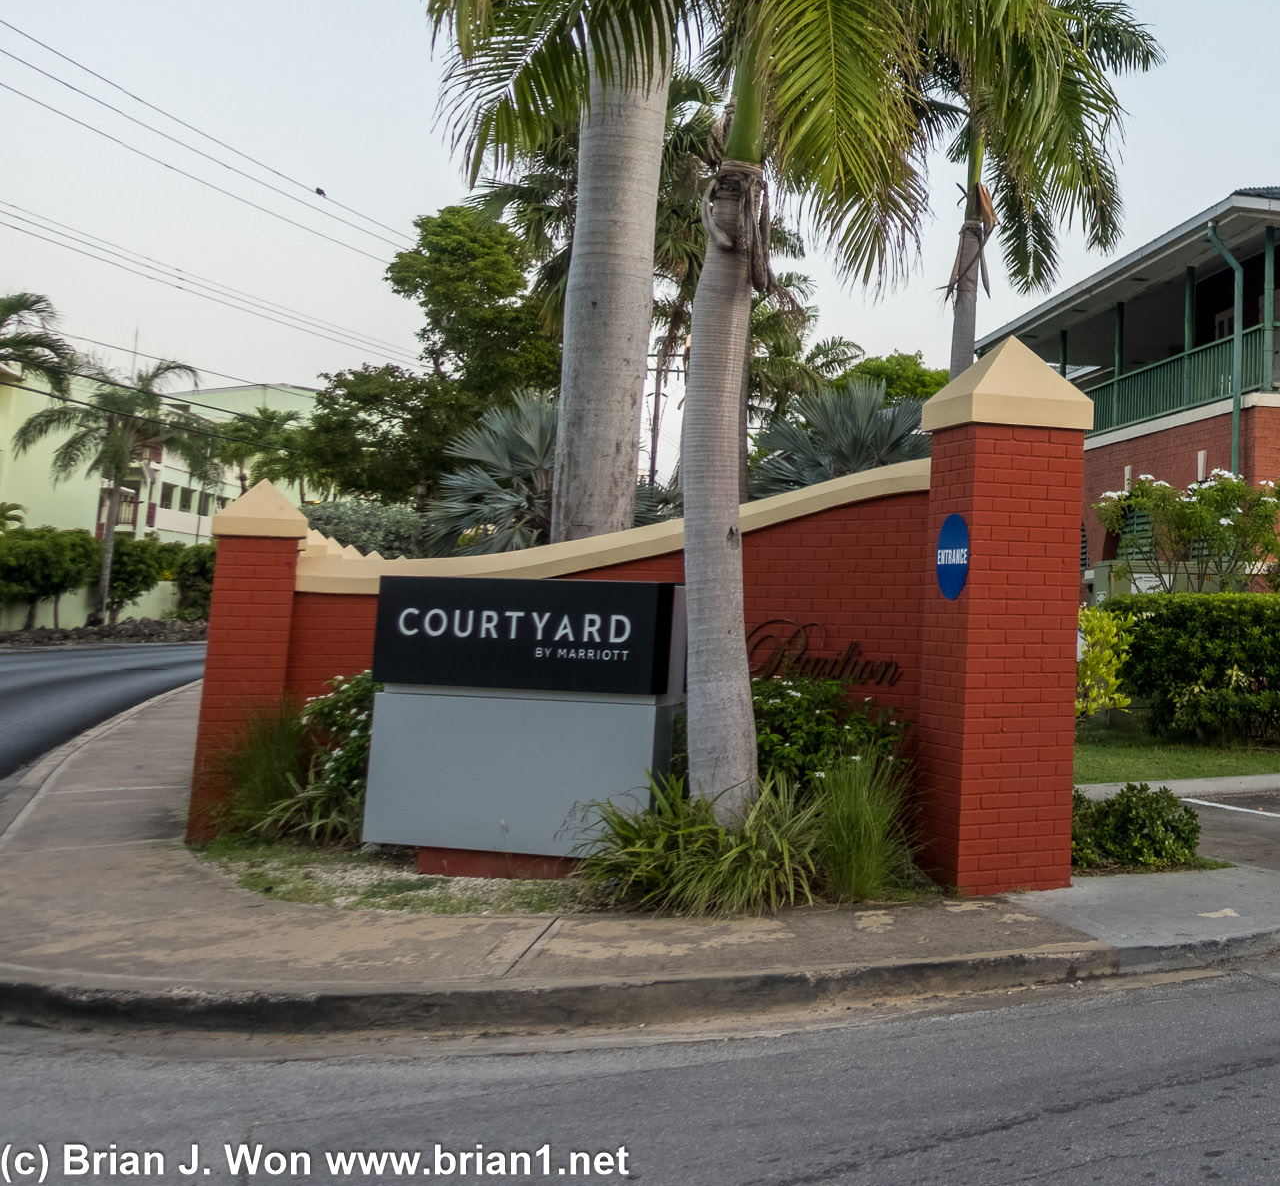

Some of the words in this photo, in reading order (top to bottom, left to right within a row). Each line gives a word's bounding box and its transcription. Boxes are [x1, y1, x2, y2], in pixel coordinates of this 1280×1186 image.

[936, 547, 968, 565] ENTRANCE
[398, 607, 632, 644] COURTYARD
[535, 646, 552, 659] BY
[557, 648, 630, 662] MARRIOTT
